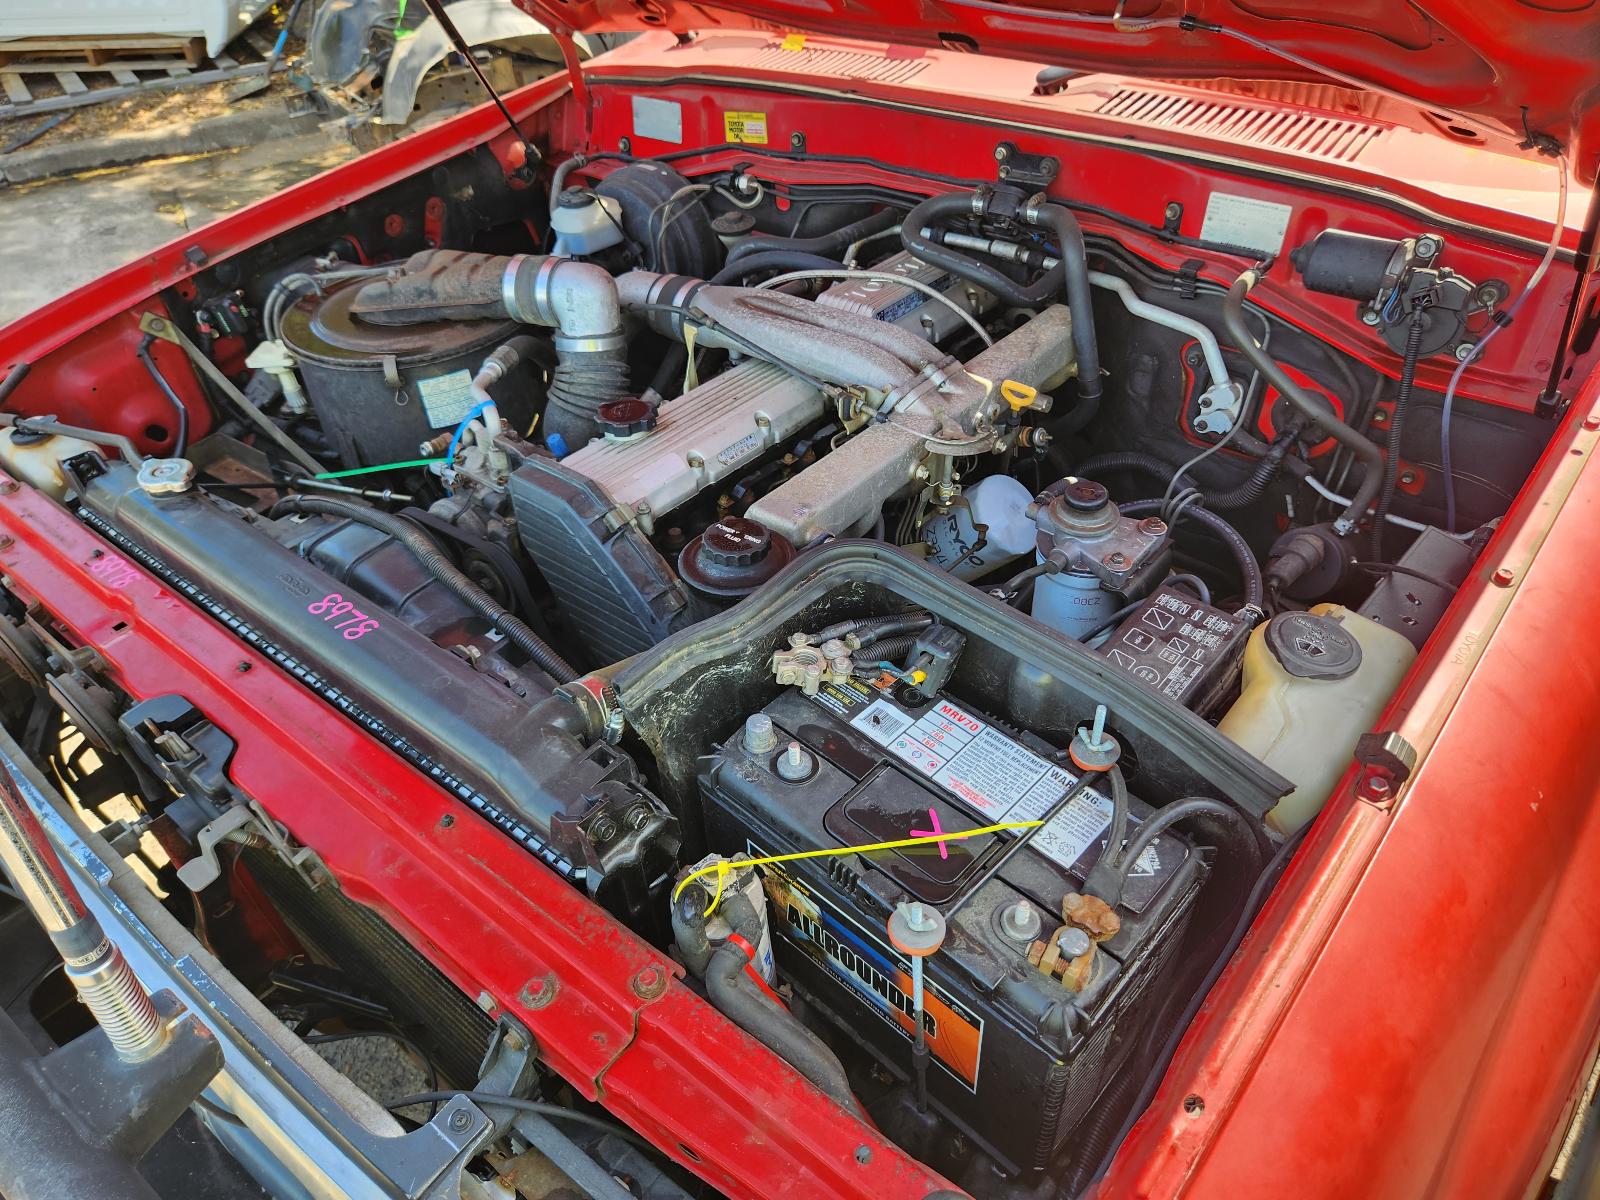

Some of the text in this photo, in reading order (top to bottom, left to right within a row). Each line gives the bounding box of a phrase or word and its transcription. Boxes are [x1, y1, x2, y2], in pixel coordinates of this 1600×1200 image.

[715, 523, 736, 534] POWER
[724, 533, 742, 543] FLUID
[307, 593, 380, 640] 8978
[940, 704, 979, 732] MRV70
[984, 730, 1048, 770] WARRANTY STATEMENT
[786, 902, 938, 1040] ALLROUNDER
[856, 989, 885, 1020] STARTING
[884, 1014, 912, 1038] BATTERY
